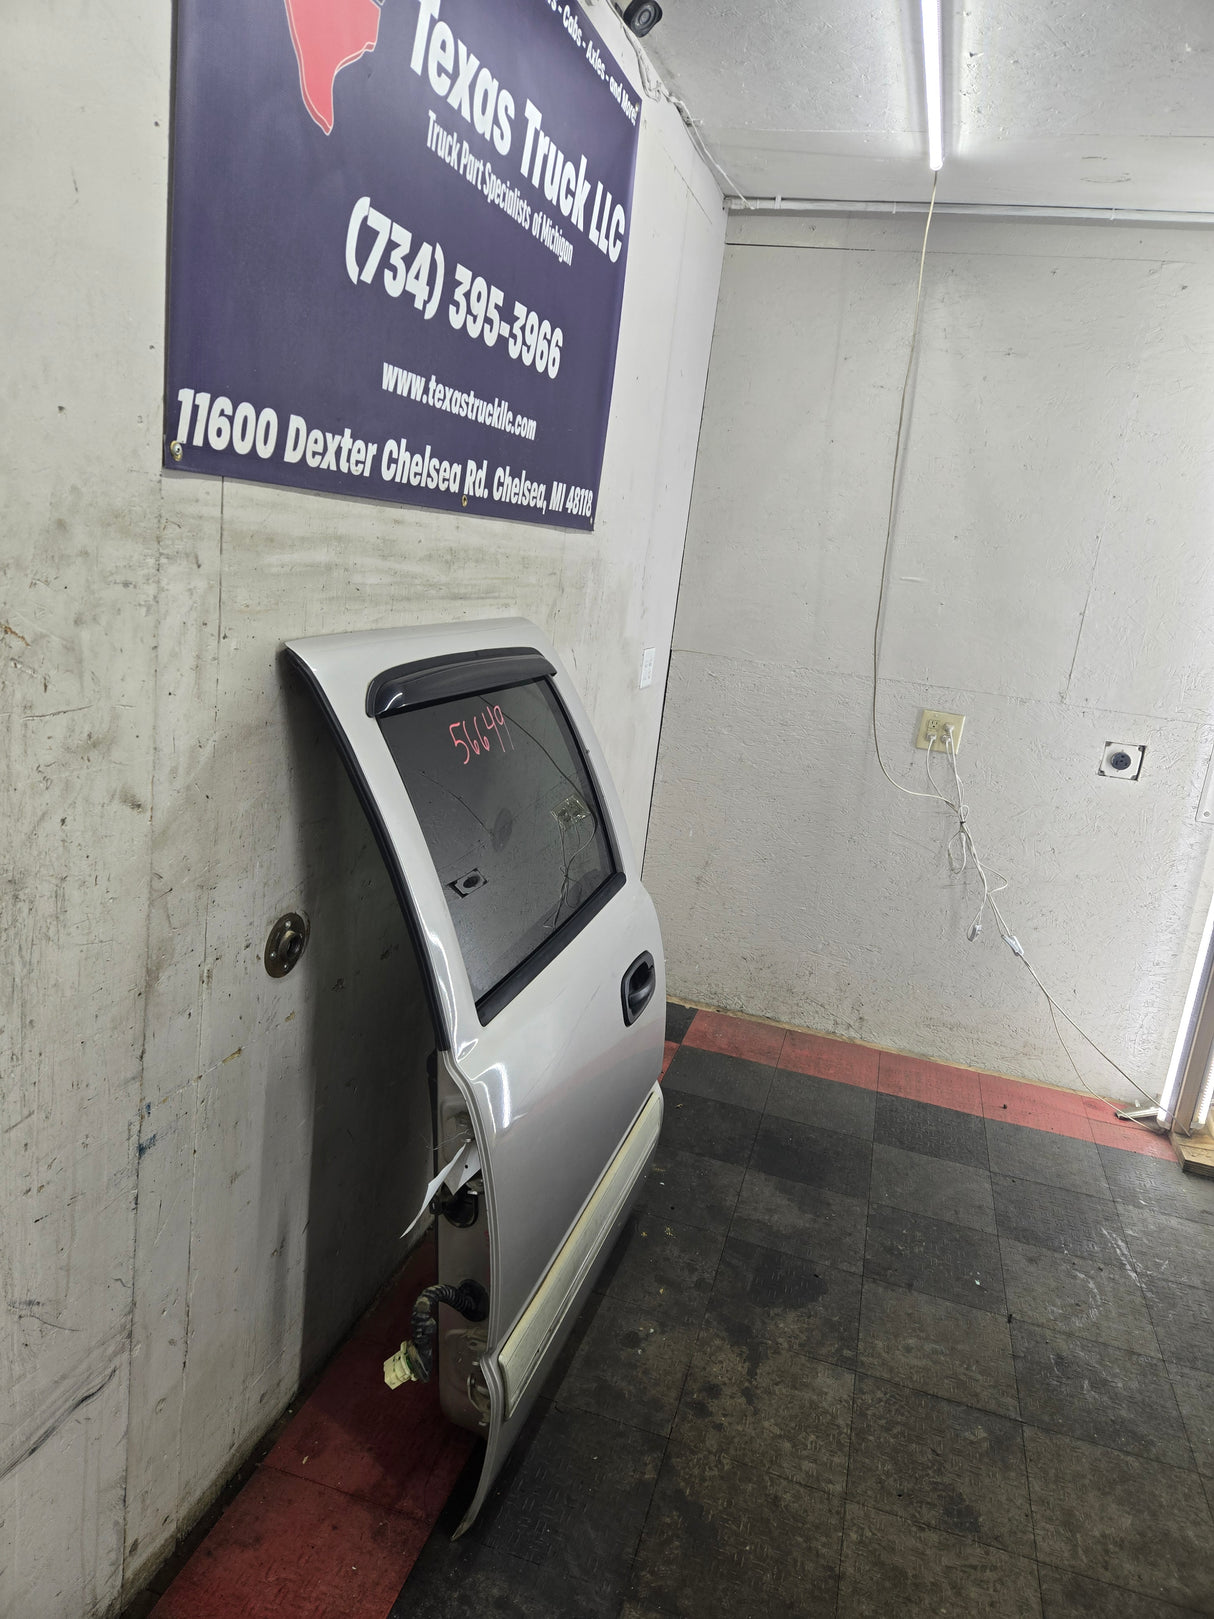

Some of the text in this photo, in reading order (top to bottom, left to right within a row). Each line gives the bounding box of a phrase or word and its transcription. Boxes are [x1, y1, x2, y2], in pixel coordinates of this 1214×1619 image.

[563, 4, 582, 47] Cabs
[586, 40, 605, 80] Axles
[609, 76, 623, 104] and
[410, 0, 626, 263] Texas Truck LLC
[426, 109, 574, 266] Truck Part Specialists of Michigan
[345, 196, 563, 379] (734) 395-3966
[176, 388, 593, 518] 11600 Dexter Chelsea Rd. Chelsea, MI 48118
[381, 362, 537, 441] www.texastruckllc.com
[449, 704, 515, 765] 56649
